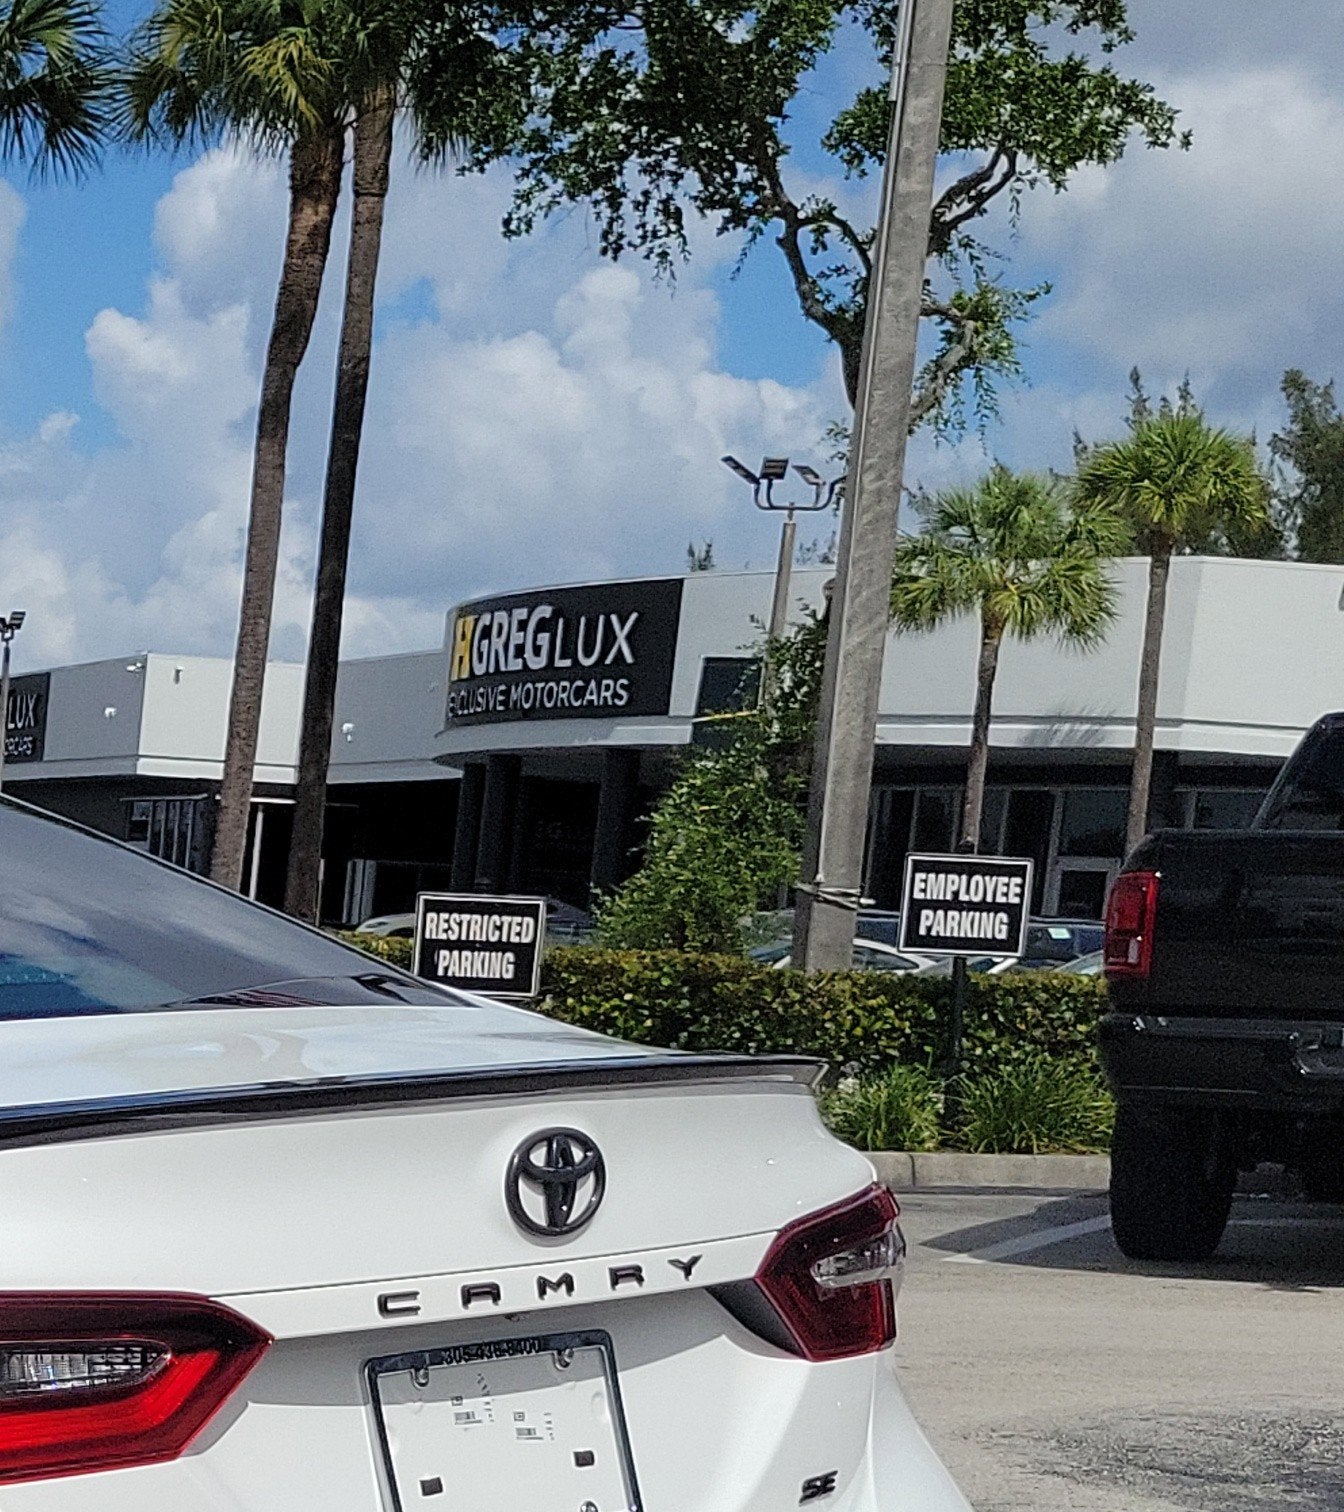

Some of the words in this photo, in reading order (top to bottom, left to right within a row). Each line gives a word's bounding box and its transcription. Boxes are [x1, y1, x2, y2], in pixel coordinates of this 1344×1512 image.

[554, 611, 639, 668] LUX
[8, 691, 37, 730] LUX
[448, 685, 507, 717] EXCLUSIVE
[509, 678, 631, 711] MOTORCARS
[912, 871, 1024, 904] EMPLOYEE
[424, 909, 536, 944] RESTRICTED
[916, 908, 1010, 942] PARKING
[435, 950, 516, 981] PARKING
[377, 1253, 703, 1319] CAMRY
[798, 1470, 839, 1504] SE
